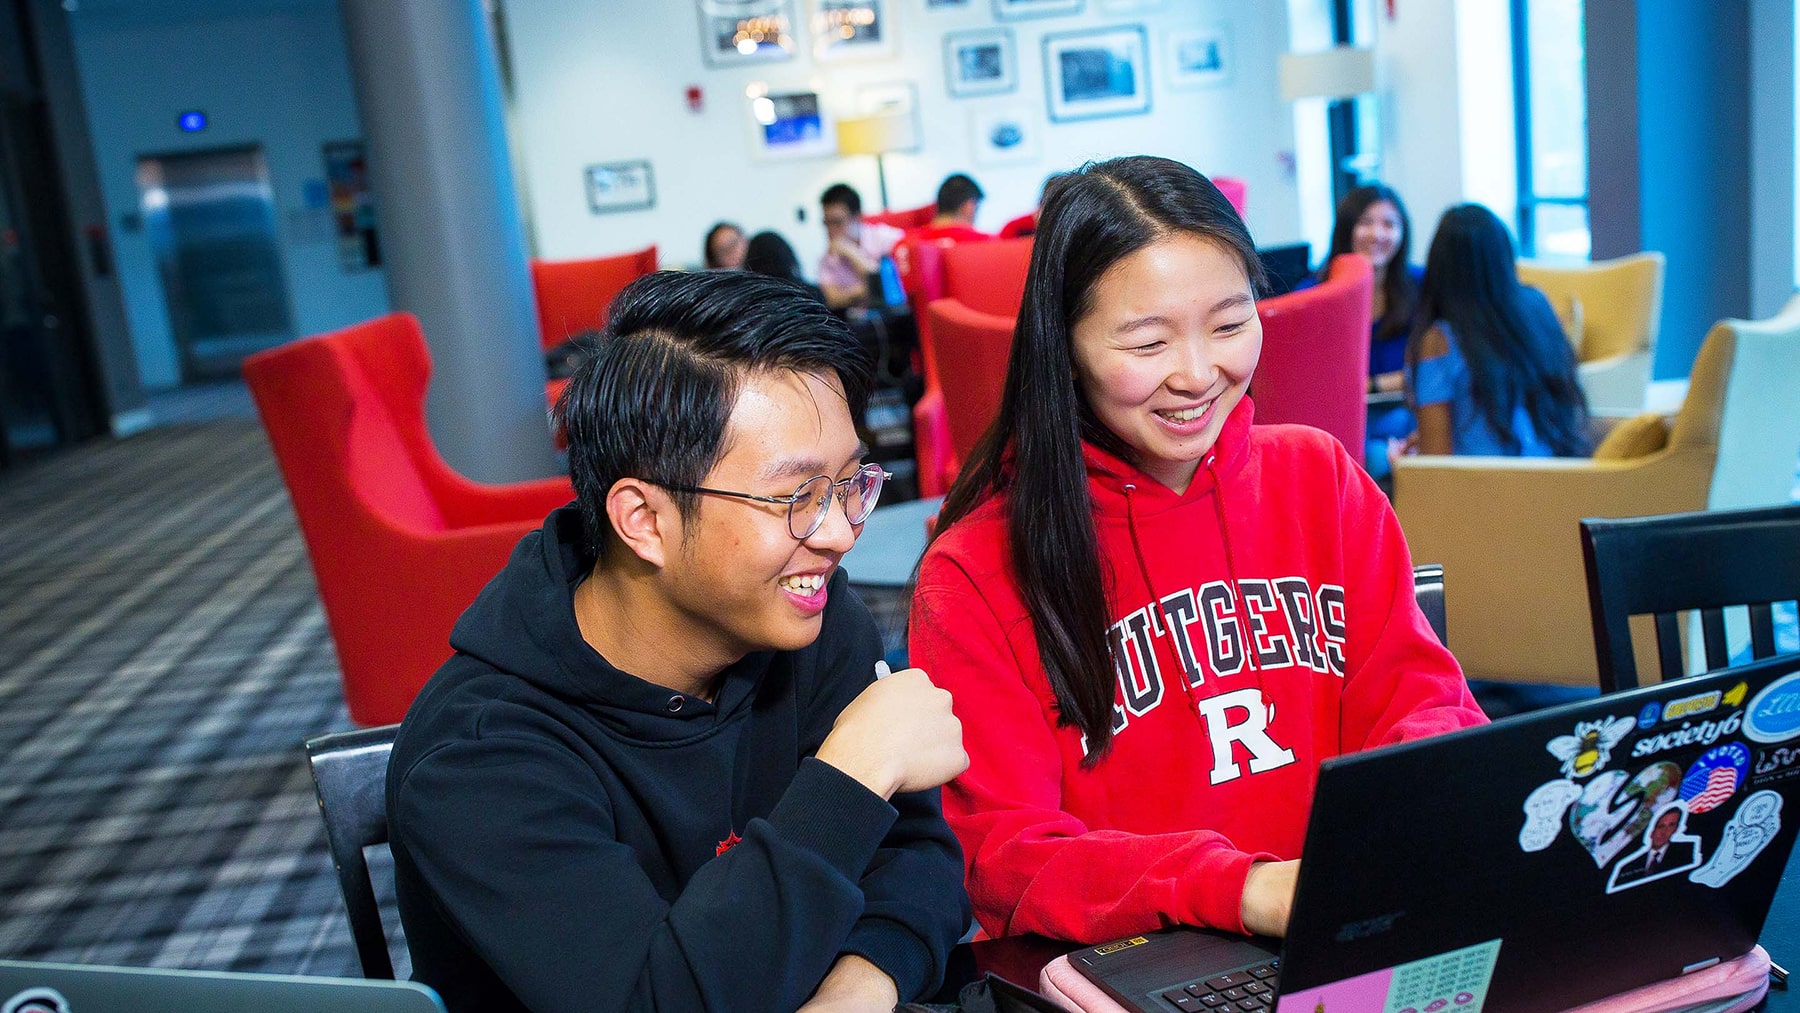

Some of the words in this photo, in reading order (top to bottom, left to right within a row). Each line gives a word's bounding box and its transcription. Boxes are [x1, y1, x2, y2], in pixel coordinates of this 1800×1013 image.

[1198, 687, 1297, 786] R
[1631, 710, 1744, 757] society6
[1707, 746, 1746, 767] VOTED
